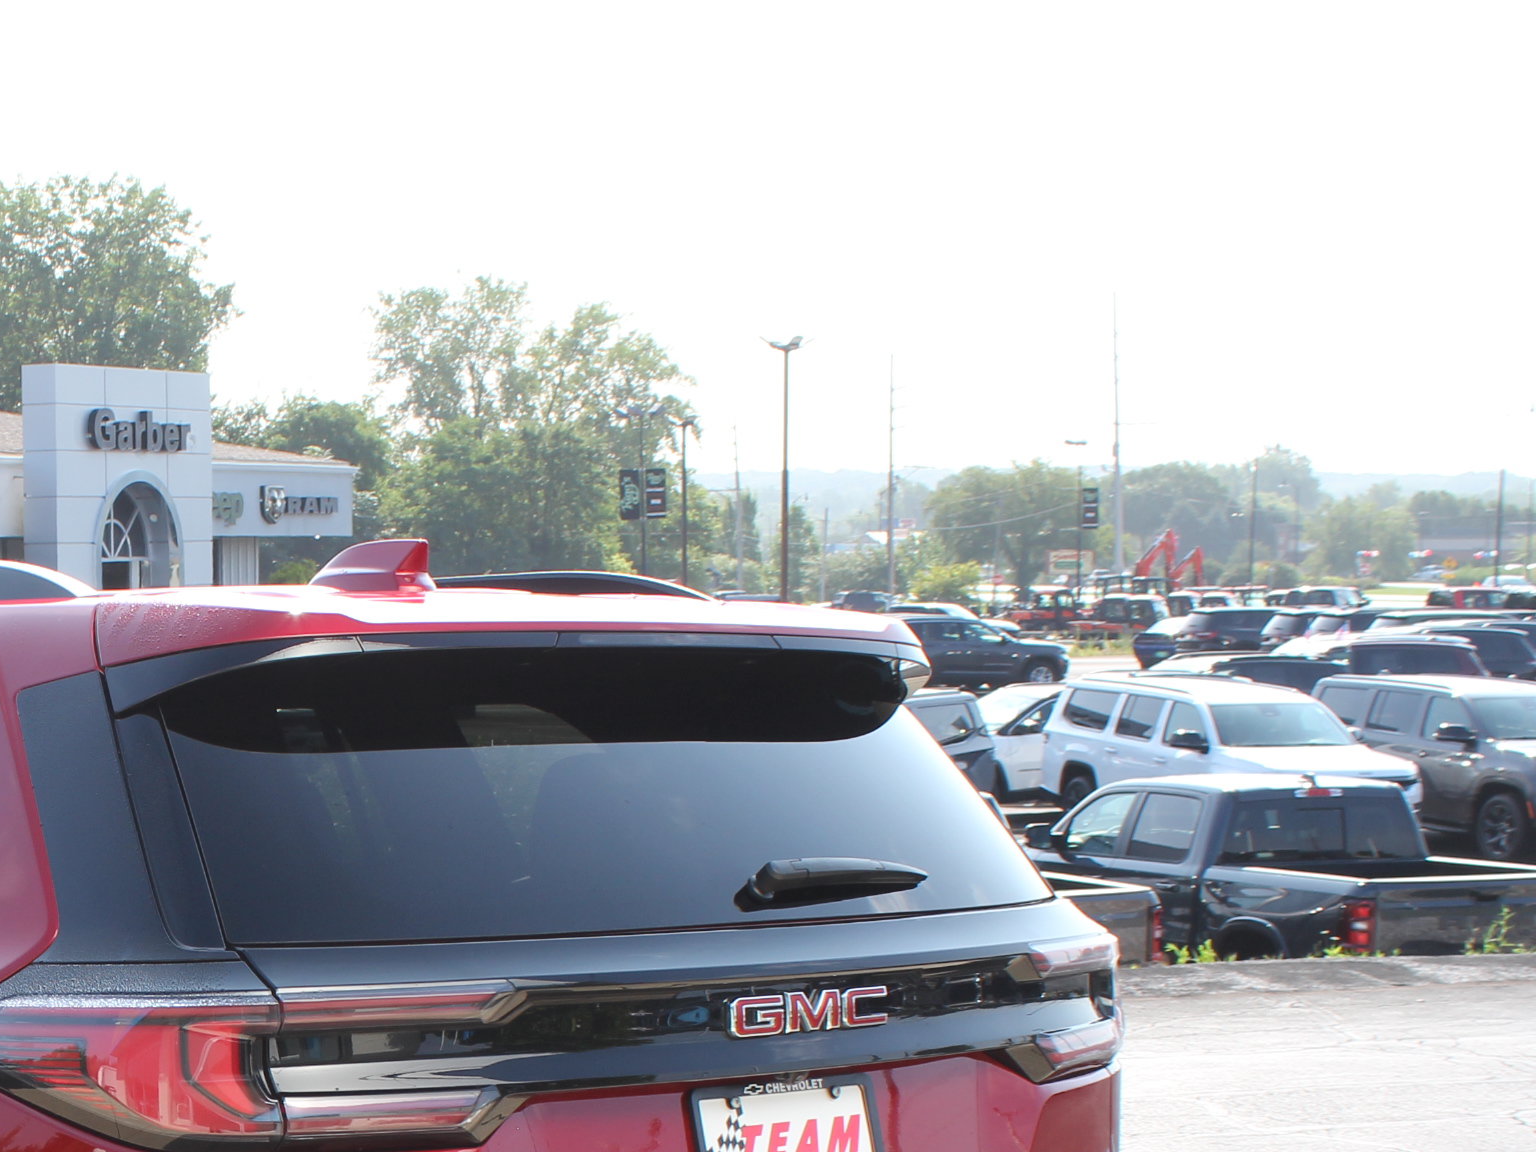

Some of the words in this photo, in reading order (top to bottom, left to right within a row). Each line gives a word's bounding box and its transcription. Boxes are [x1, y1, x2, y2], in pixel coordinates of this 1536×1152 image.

[88, 408, 191, 453] Garber
[212, 491, 244, 527] eep
[284, 496, 339, 514] RAM
[726, 986, 888, 1038] GMC
[765, 1079, 823, 1094] CHEVROLET
